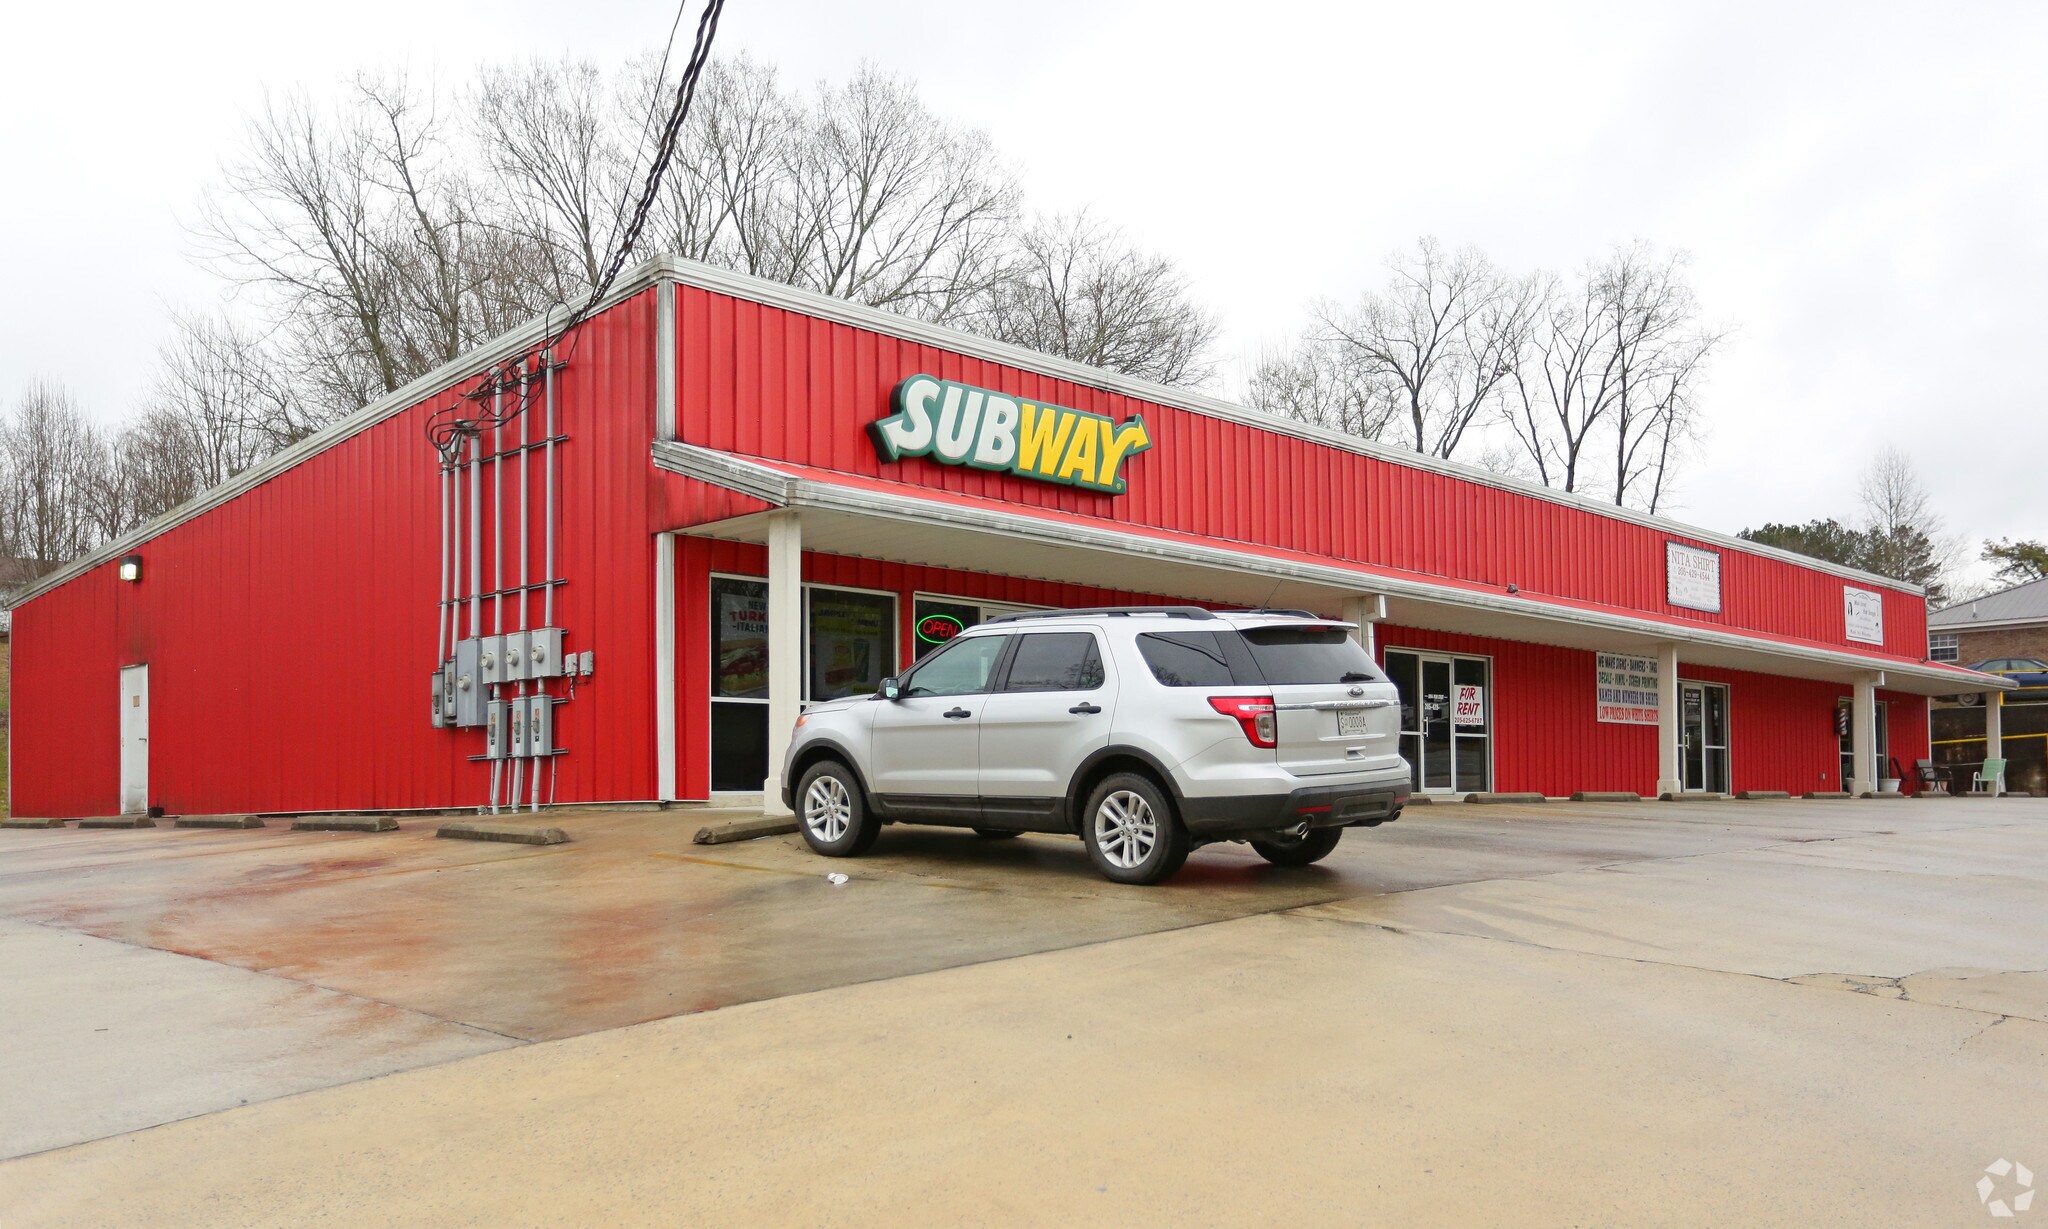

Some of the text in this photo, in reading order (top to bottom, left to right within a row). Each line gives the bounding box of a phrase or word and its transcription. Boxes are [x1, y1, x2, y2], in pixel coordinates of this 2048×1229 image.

[883, 379, 1149, 486] SUBWAY
[1671, 550, 1716, 573] NITA SHIRT
[729, 610, 767, 623] TURK
[922, 620, 959, 638] OPEN
[1460, 687, 1476, 700] FOR
[1457, 702, 1480, 715] RENT
